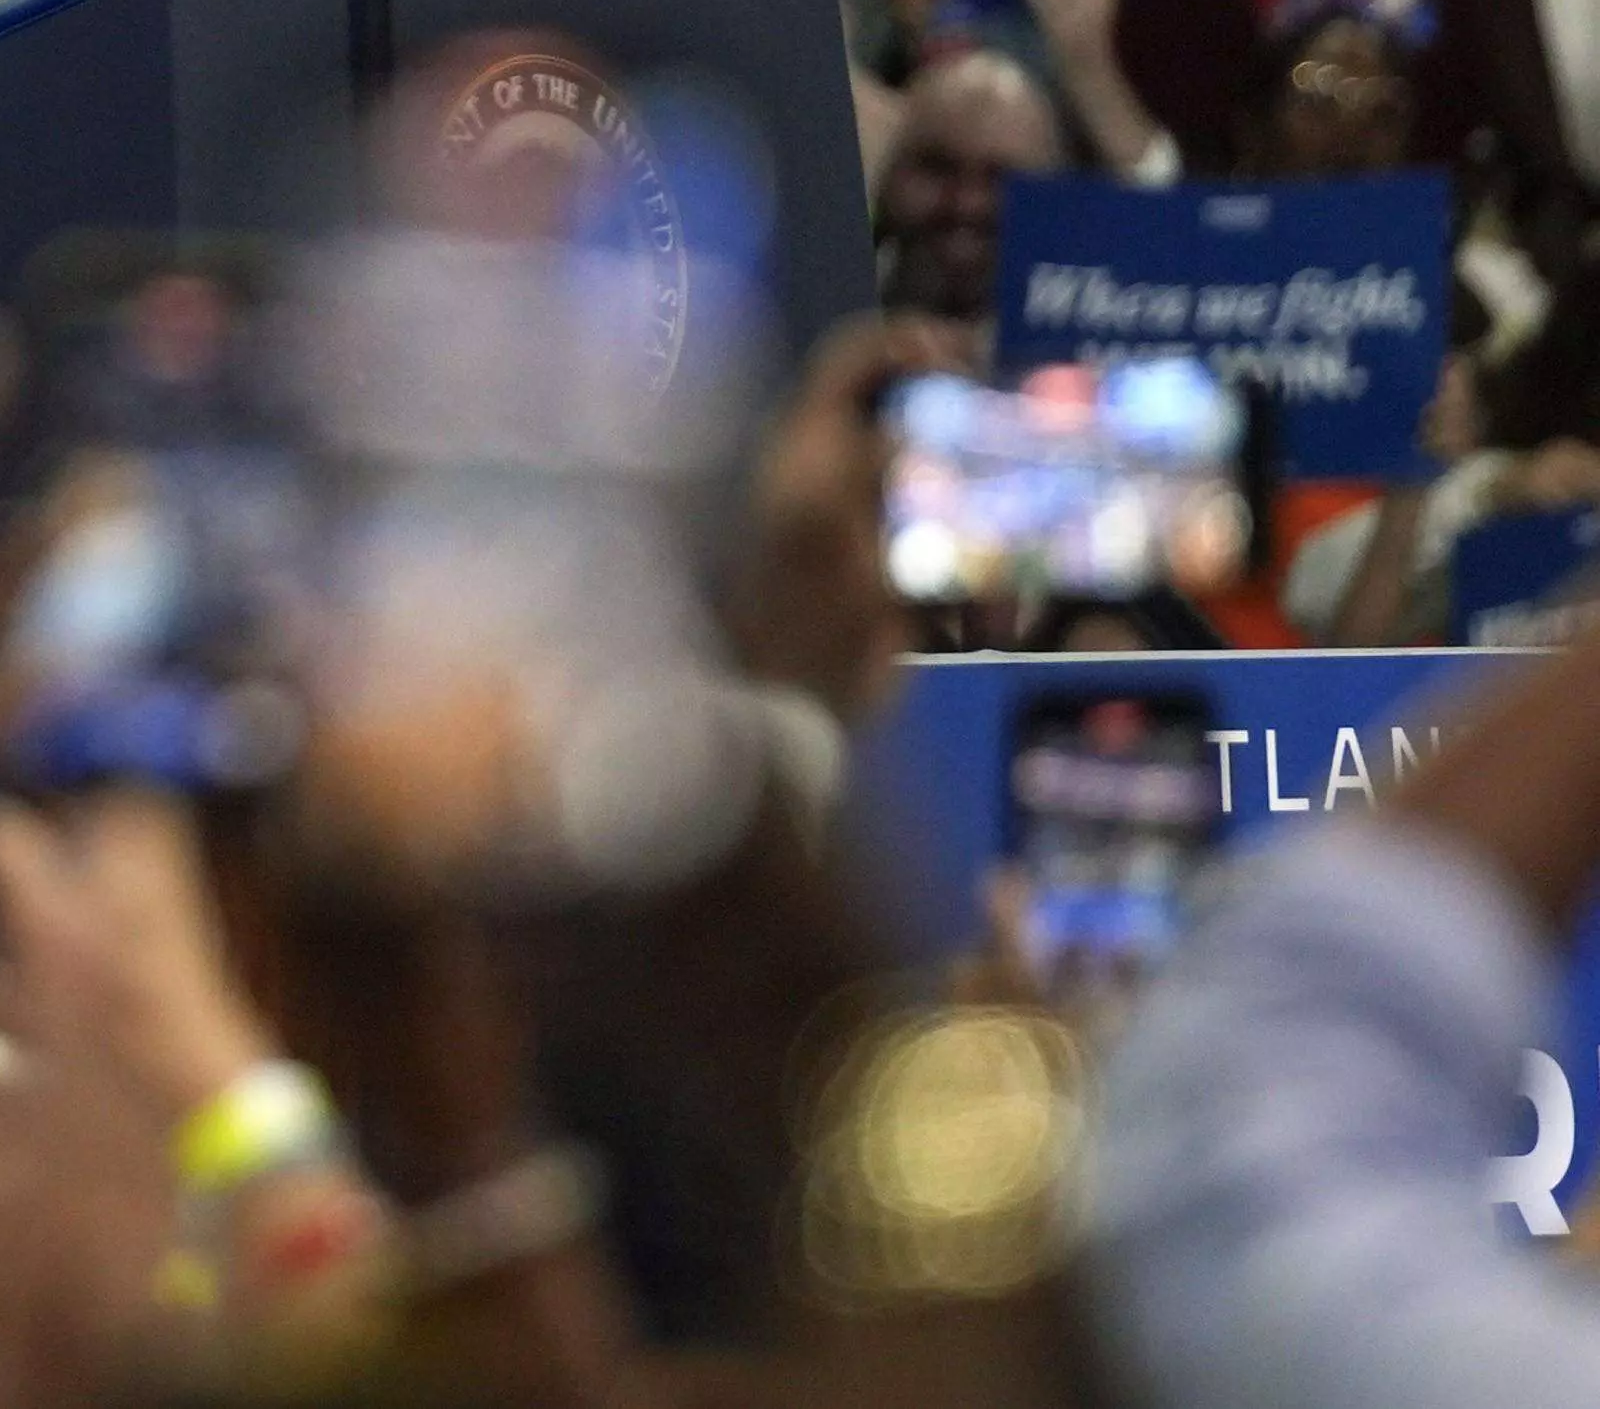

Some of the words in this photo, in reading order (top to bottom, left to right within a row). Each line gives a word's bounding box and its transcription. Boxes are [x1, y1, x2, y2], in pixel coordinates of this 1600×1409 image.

[492, 75, 525, 110] OF
[532, 73, 590, 111] THE
[1202, 726, 1442, 814] TLAN
